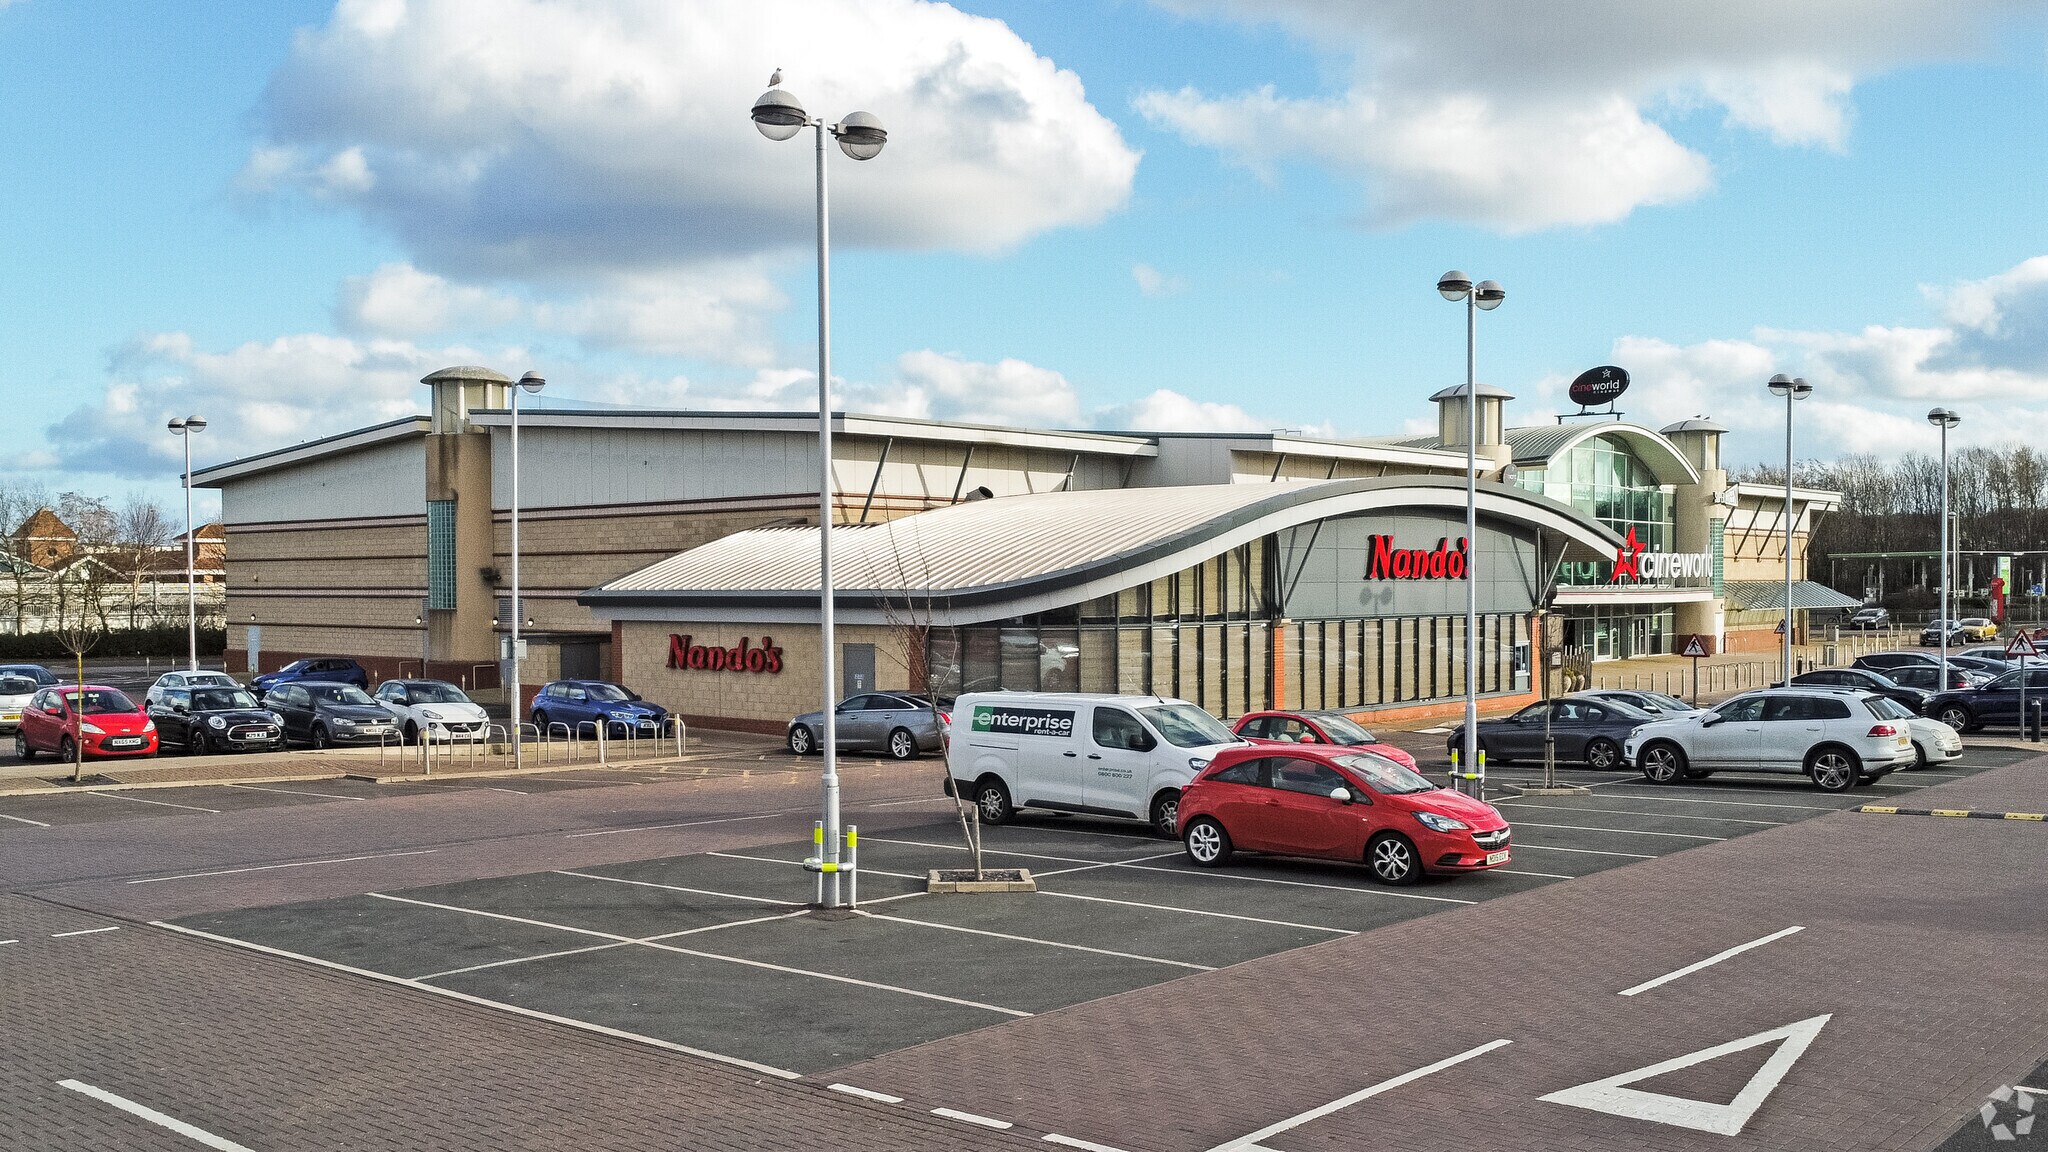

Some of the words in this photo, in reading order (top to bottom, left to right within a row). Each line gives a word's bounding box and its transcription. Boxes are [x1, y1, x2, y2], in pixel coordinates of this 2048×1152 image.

[1572, 379, 1620, 392] cineworld
[1640, 544, 1714, 579] cineworld
[666, 633, 783, 673] Nando's
[977, 711, 1072, 731] enterprise
[1033, 728, 1070, 736] rent-a-car
